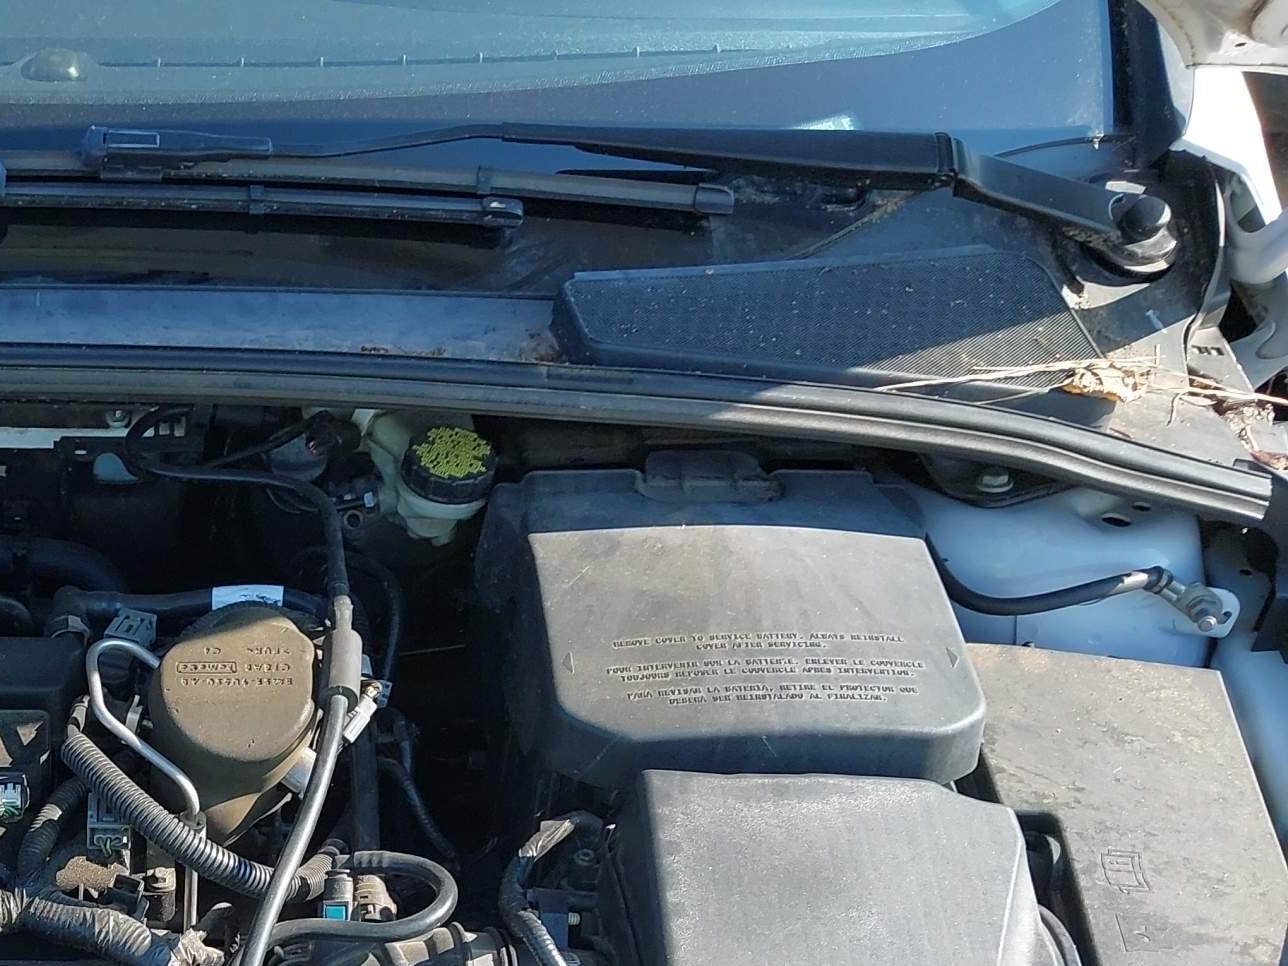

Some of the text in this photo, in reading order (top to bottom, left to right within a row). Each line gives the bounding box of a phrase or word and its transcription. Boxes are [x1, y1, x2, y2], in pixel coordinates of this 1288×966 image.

[654, 635, 687, 645] COVER
[690, 634, 705, 643] TO
[708, 632, 752, 642] SERVICE
[809, 632, 845, 641] ALWAYS
[850, 634, 904, 643] REINSTALL
[695, 642, 728, 651] COVER
[731, 641, 763, 649] AFTER
[605, 666, 632, 676] POUR
[804, 658, 848, 666] ENLEVER
[852, 658, 866, 666] LE
[869, 659, 926, 669] COUVERCLE
[619, 671, 670, 683] TOUJOURS
[723, 668, 738, 676] LE
[741, 667, 798, 675] COUVERCLE
[626, 690, 653, 701] PARA
[706, 686, 721, 694] LA
[778, 683, 817, 692] RETIRE
[822, 684, 835, 692] EL
[839, 684, 895, 693] PROTECTOR
